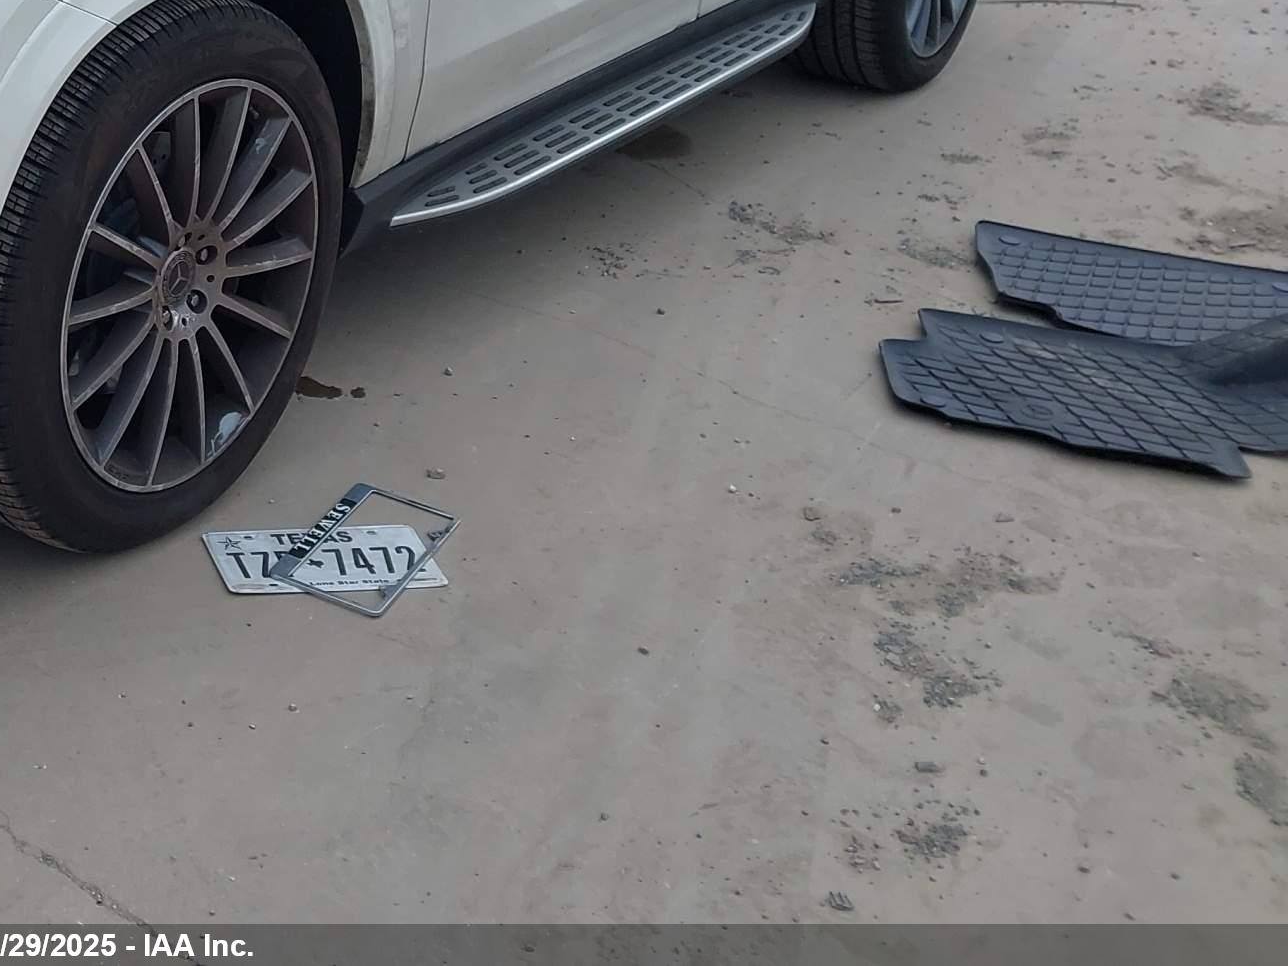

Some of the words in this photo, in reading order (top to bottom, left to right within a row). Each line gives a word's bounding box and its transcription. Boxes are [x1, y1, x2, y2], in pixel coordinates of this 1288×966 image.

[270, 531, 353, 545] TEAS
[294, 503, 351, 551] SEWELL
[321, 545, 427, 576] 7472
